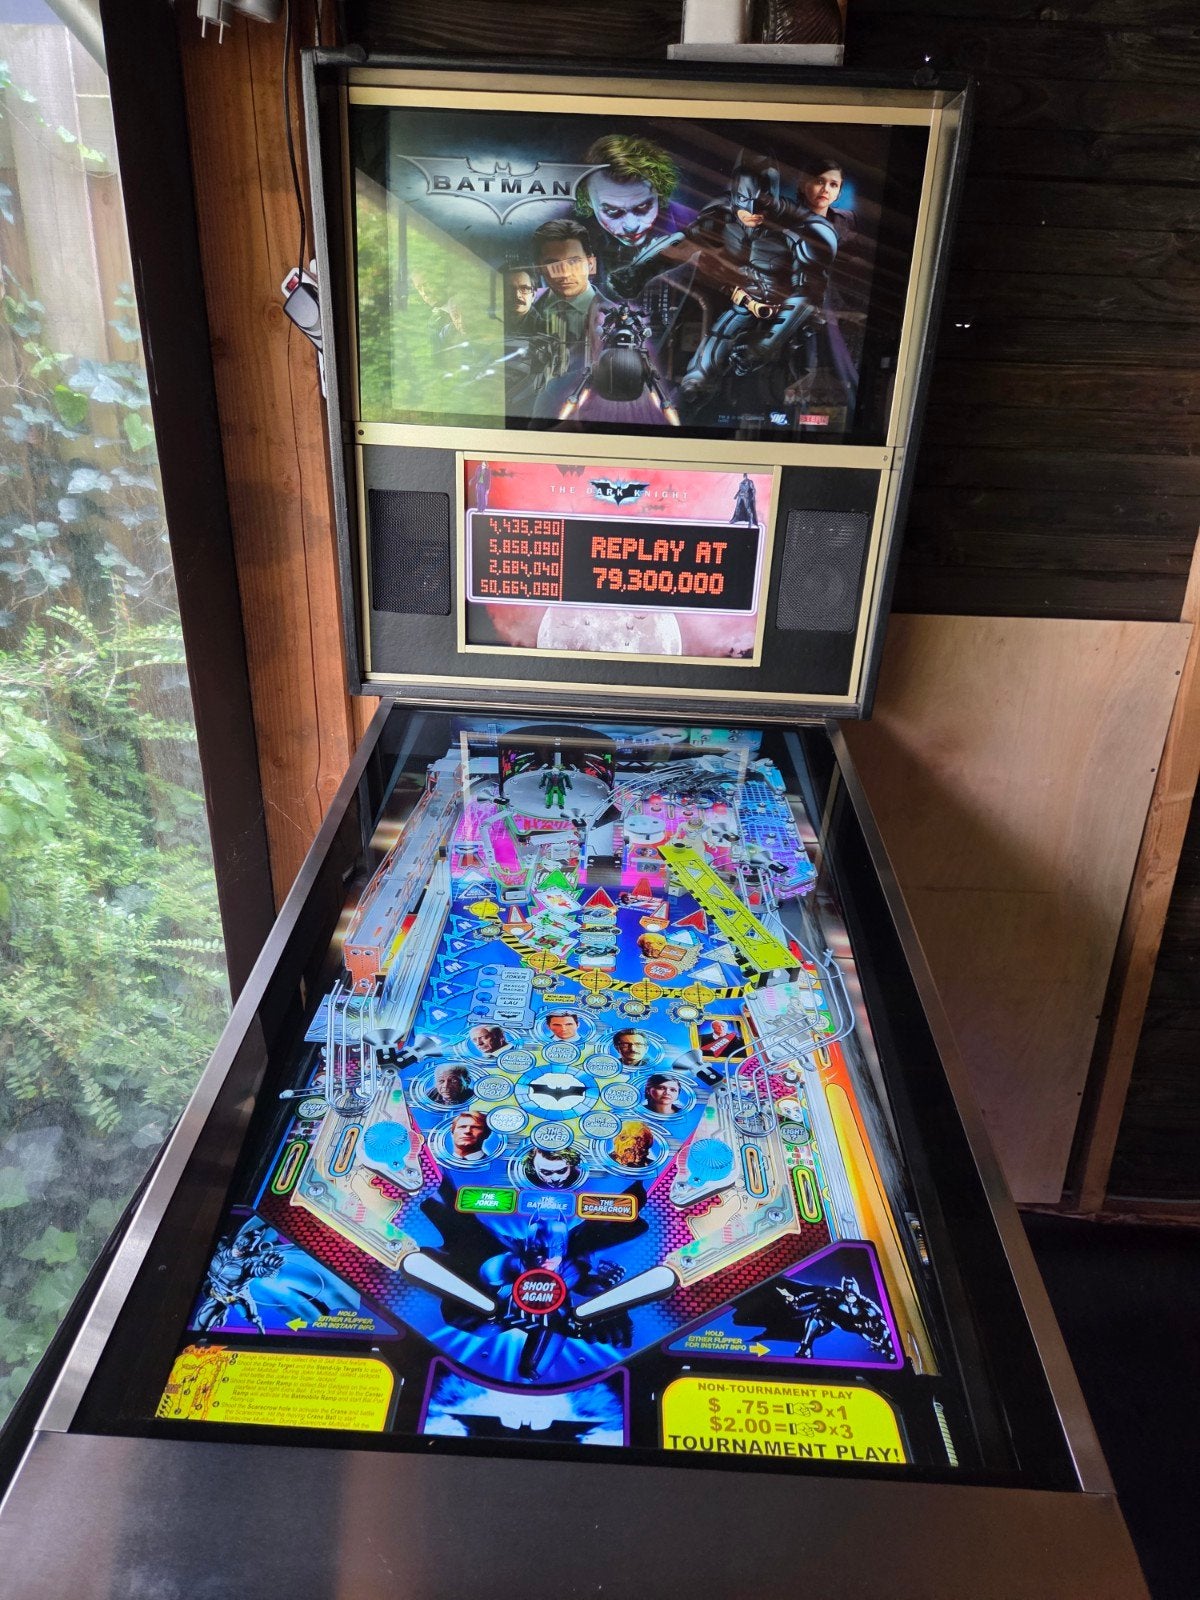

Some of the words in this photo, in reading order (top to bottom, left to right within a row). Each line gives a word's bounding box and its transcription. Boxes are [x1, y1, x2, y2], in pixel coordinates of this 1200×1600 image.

[433, 175, 571, 196] BATMAN
[551, 485, 576, 494] THE
[586, 488, 624, 497] DARK
[634, 489, 688, 499] KNIGHT
[489, 518, 560, 536] 4,435,290
[489, 538, 560, 557] 5,858,090
[591, 536, 685, 564] REPLAY
[696, 541, 728, 564] AT
[489, 559, 559, 578] 2,684,040
[480, 578, 558, 598] 50,664,090
[592, 566, 724, 596] 79,300,000
[538, 1133, 568, 1142] JOKER
[474, 1199, 500, 1207] JOKER
[526, 1202, 568, 1211] BATMOBILE
[584, 1205, 630, 1214] SCARECROW
[522, 1281, 556, 1292] SHOOT
[521, 1292, 554, 1302] AGAIN
[328, 1322, 358, 1330] INSTANT
[344, 1317, 374, 1325] FLIPPER
[700, 1342, 730, 1350] INSTANT
[698, 1382, 817, 1398] NON-TOURNAMENT
[822, 1390, 854, 1400] PLAY
[708, 1398, 721, 1414] $
[829, 1424, 854, 1440] x3
[668, 1434, 827, 1460] TOURNAMENT
[836, 1445, 900, 1462] PLAY!
